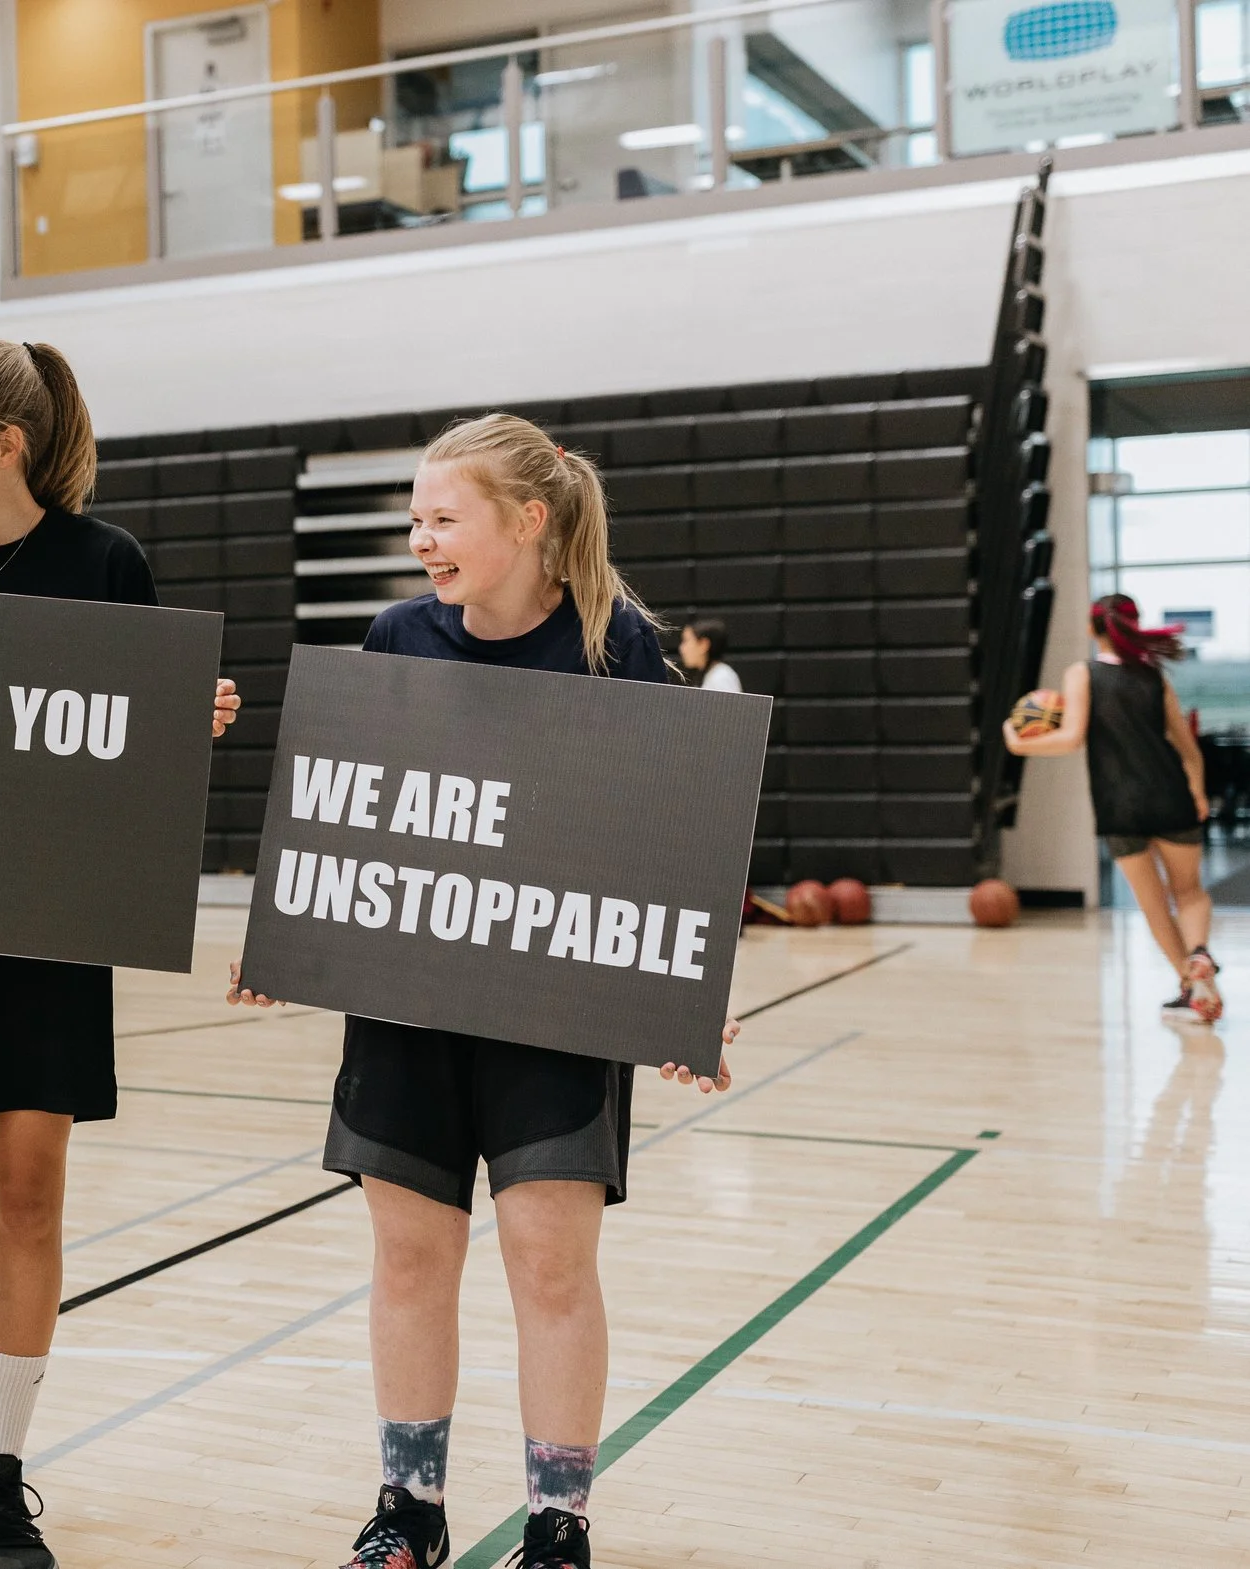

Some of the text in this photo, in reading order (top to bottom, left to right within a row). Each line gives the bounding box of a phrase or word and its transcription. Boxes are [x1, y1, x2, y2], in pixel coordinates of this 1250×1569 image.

[8, 685, 130, 760] YOU
[291, 754, 512, 848] WE ARE
[274, 848, 711, 981] UNSTOPPABLE
